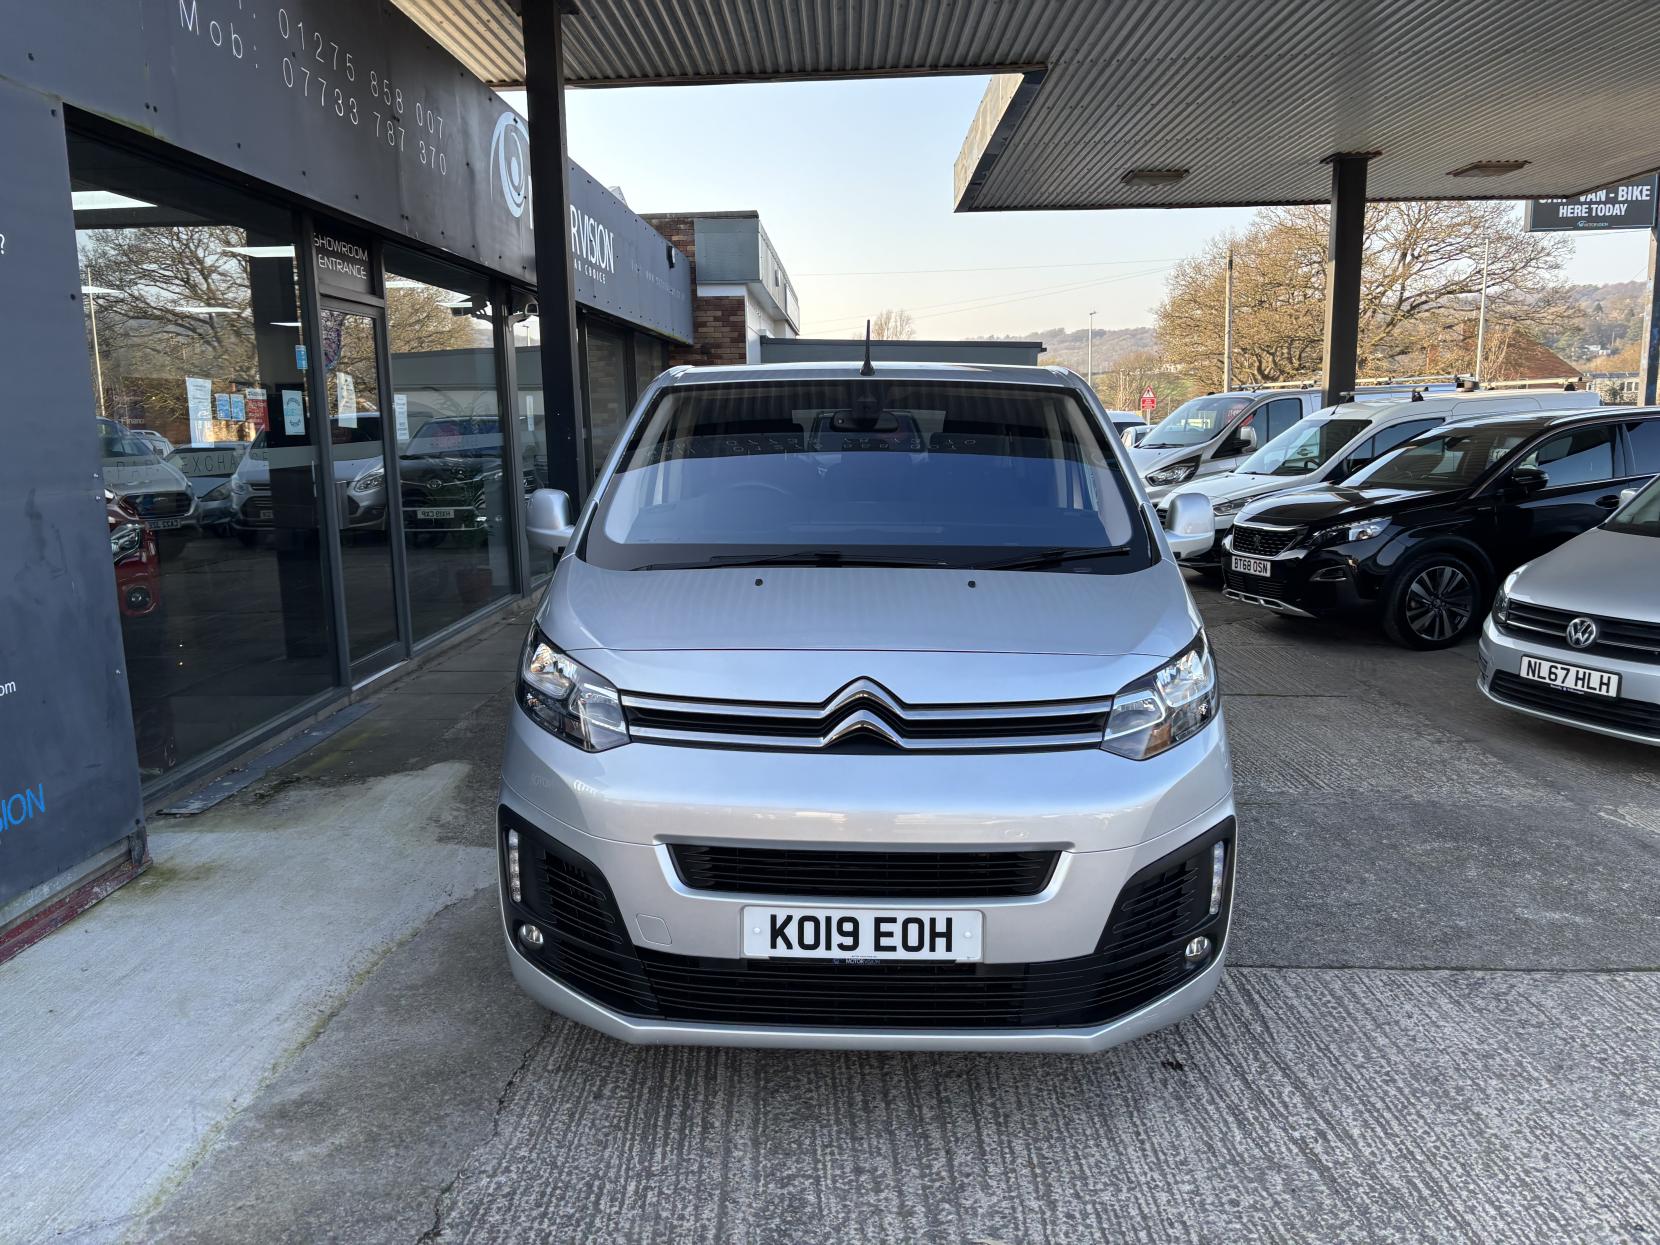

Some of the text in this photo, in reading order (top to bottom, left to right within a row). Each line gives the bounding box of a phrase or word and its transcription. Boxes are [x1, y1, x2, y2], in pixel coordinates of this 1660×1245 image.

[279, 9, 355, 82] 01275
[370, 71, 404, 113] 858
[416, 103, 443, 140] 007
[283, 58, 359, 125] 07733
[373, 112, 405, 152] 787
[420, 141, 447, 175] 370
[1618, 186, 1651, 201] BIKE
[1559, 203, 1628, 218] HERE TODAY
[313, 232, 369, 261] SHOWROOM
[318, 254, 367, 279] ENTRANCE
[1234, 557, 1268, 575] BT68 OSN
[1526, 660, 1571, 685] NL67
[1574, 669, 1612, 694] HLH
[0, 783, 46, 832] ION
[770, 914, 953, 953] KO19 EOH
